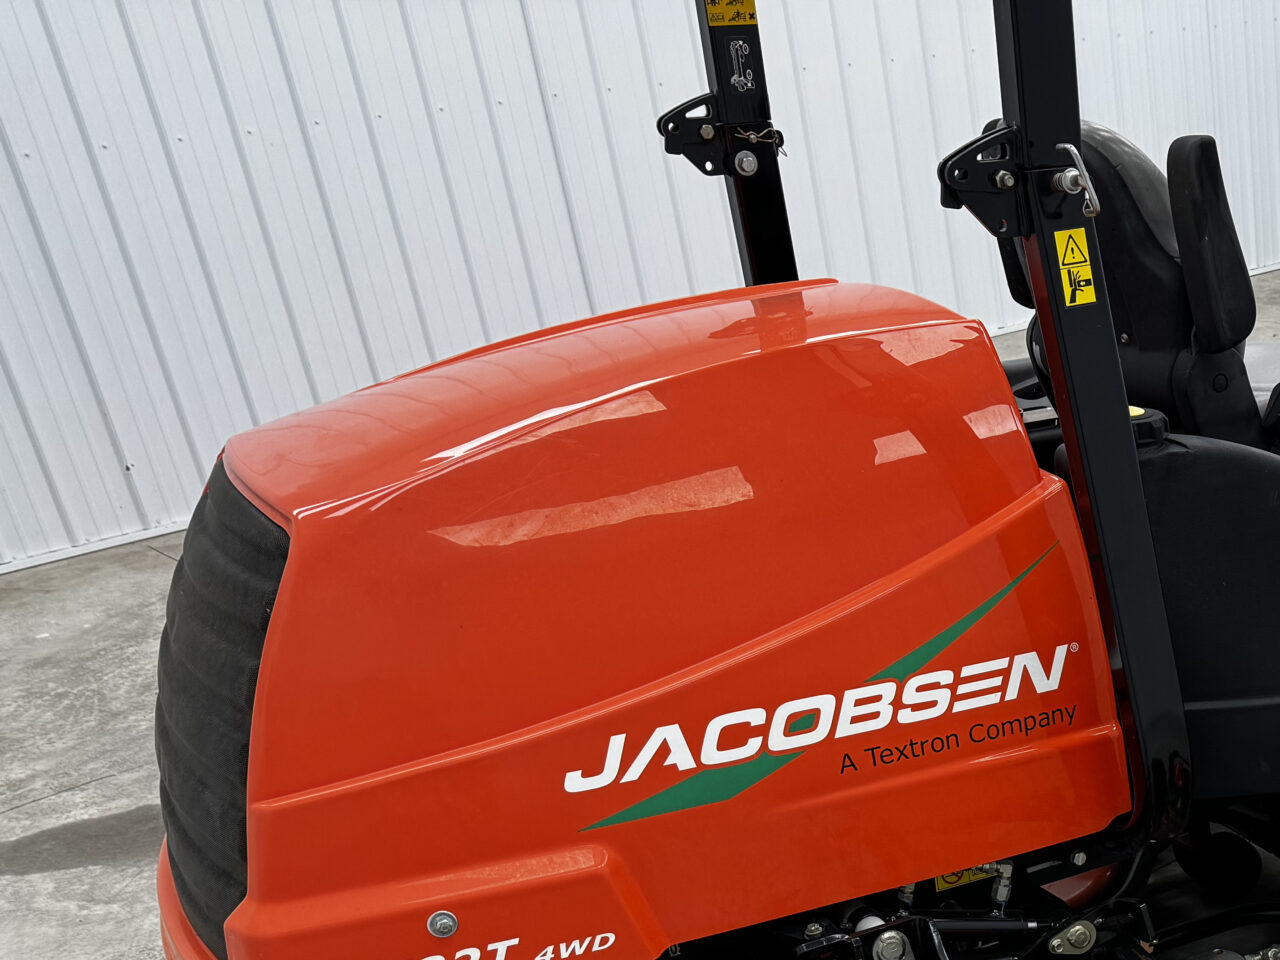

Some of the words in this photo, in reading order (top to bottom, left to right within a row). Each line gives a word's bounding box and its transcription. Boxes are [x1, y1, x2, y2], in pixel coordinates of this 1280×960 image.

[839, 752, 858, 775] A
[864, 732, 960, 767] Textron
[968, 705, 1077, 743] Company
